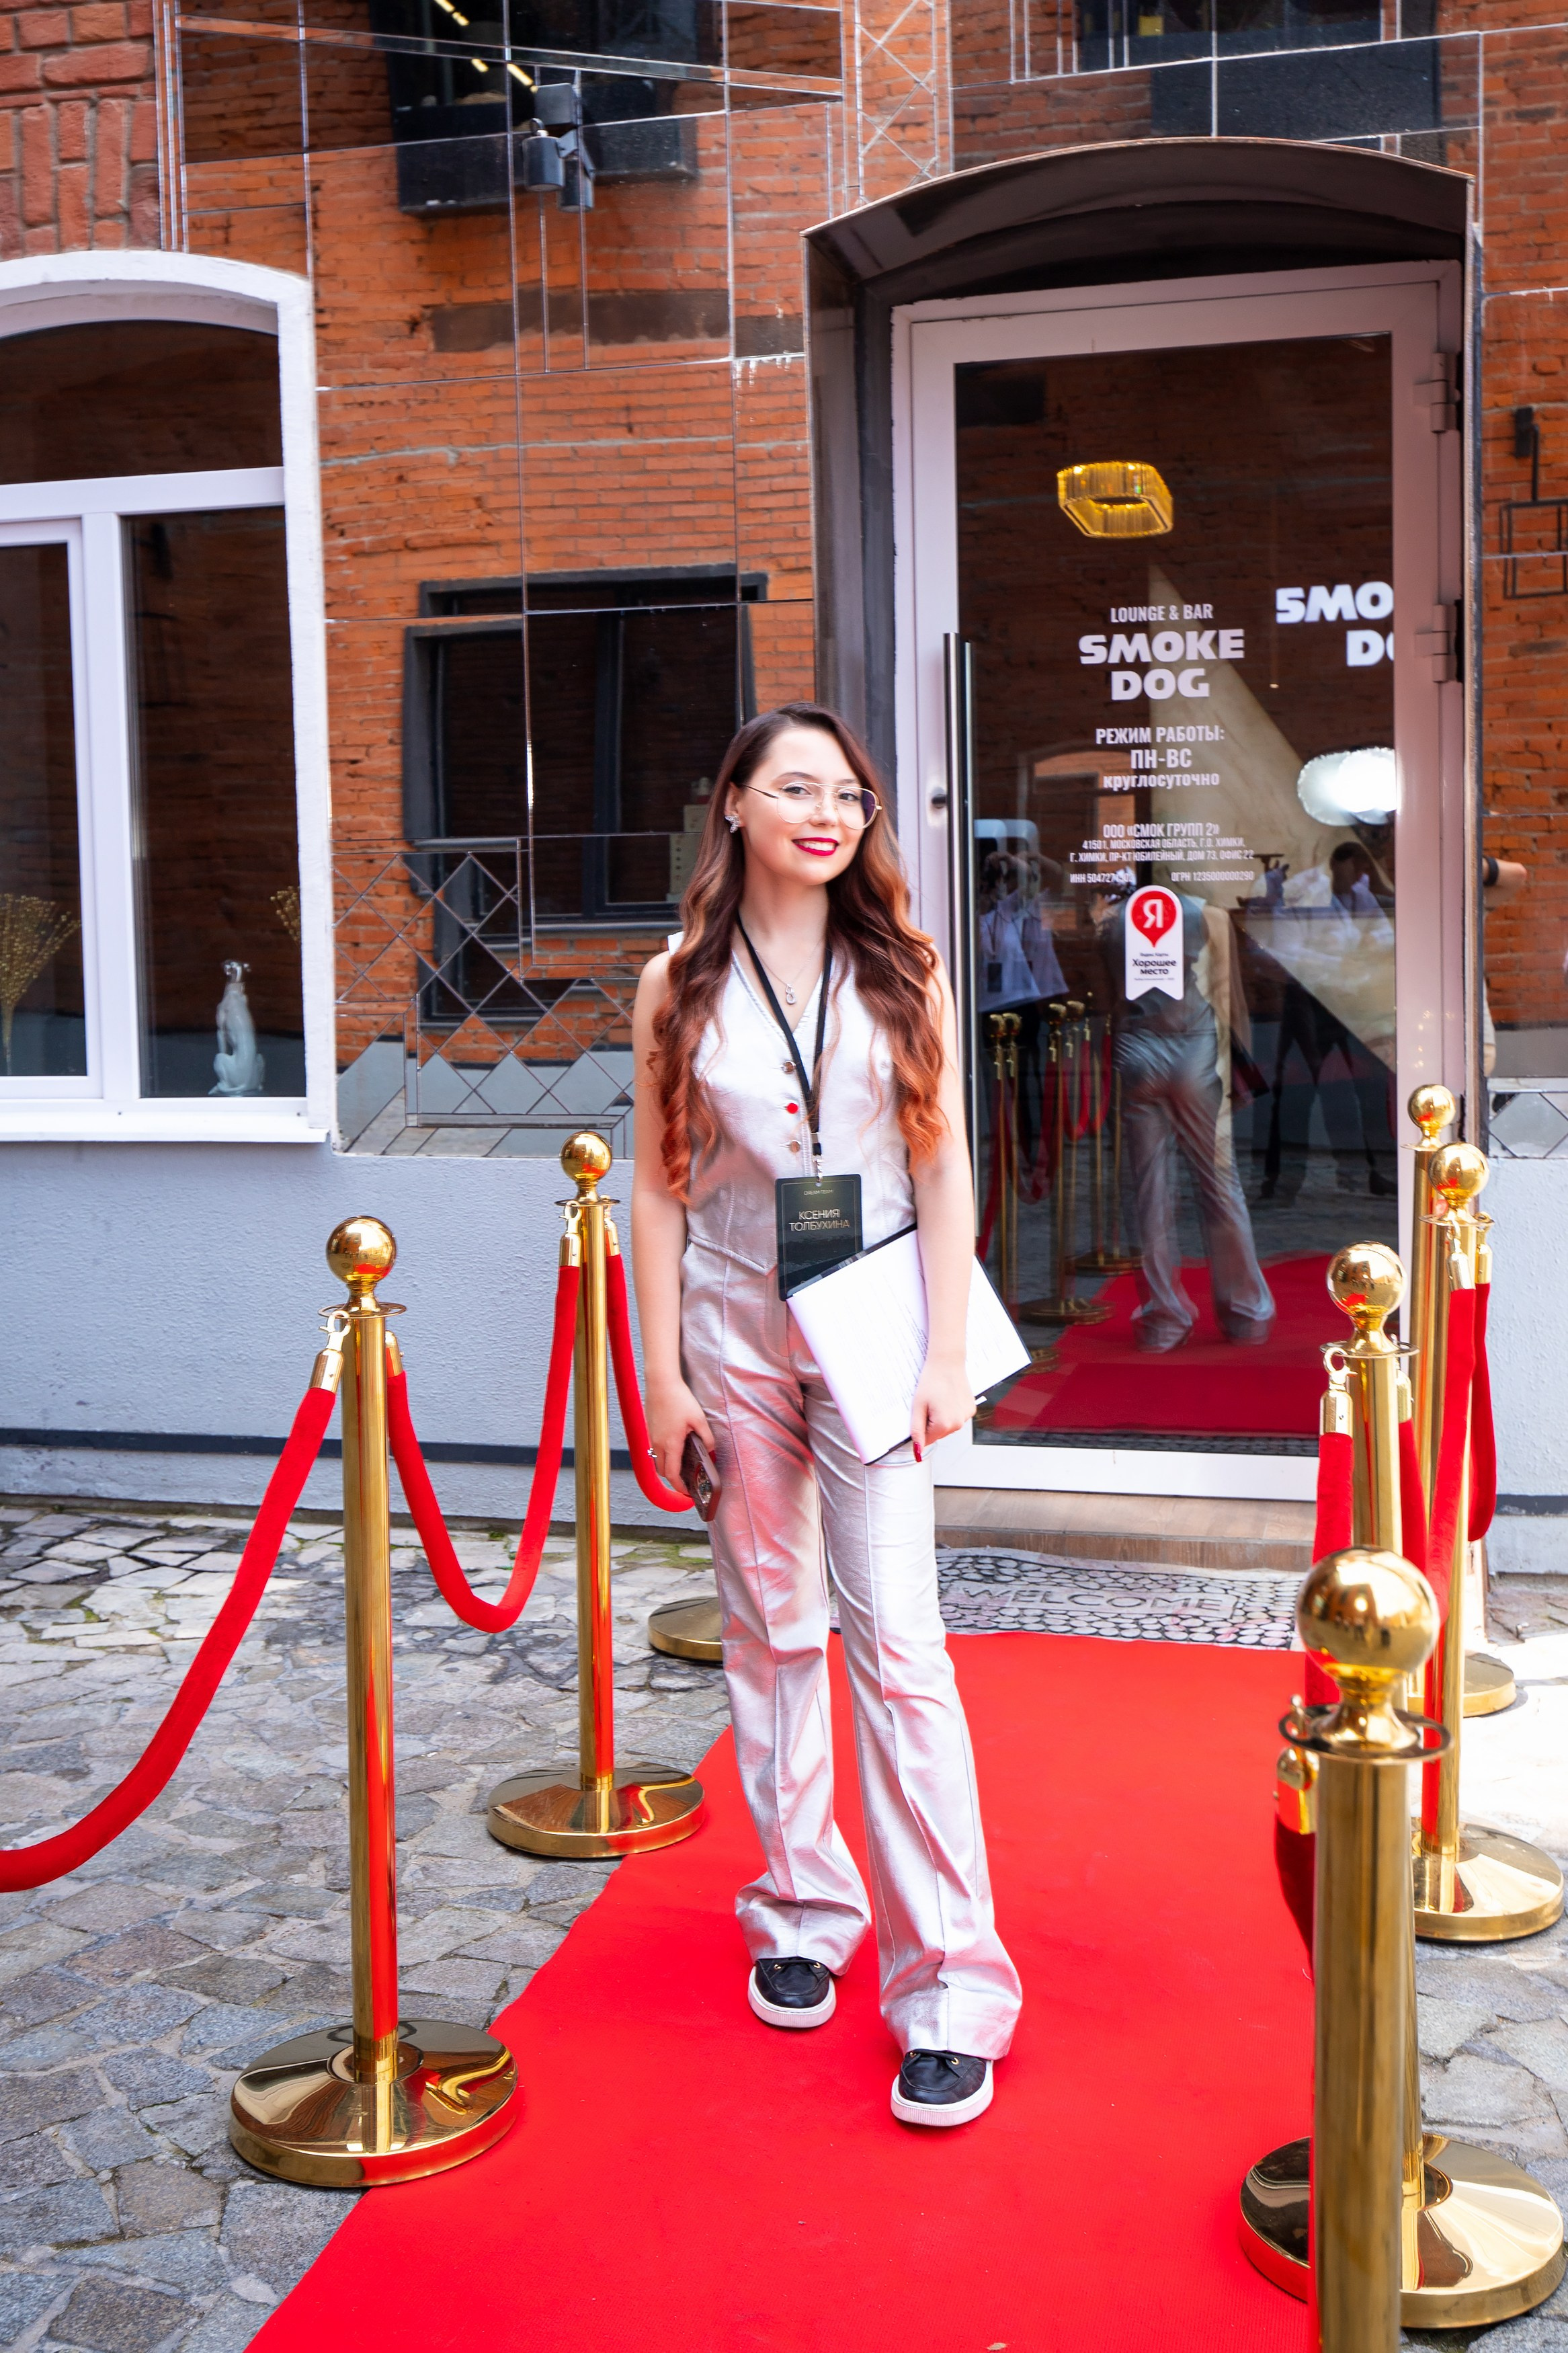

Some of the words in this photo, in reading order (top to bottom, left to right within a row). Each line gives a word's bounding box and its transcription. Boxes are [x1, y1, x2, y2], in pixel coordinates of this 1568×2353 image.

[1110, 605, 1165, 623] LOUNGE
[1169, 605, 1180, 621] &
[1184, 604, 1213, 620] BAR
[1078, 629, 1245, 664] SMOKE
[1346, 629, 1394, 667] D
[1111, 668, 1210, 701] DOG
[1096, 727, 1151, 744] РЕЖИМ
[1155, 725, 1225, 743] РАБОТЫ:
[1130, 748, 1192, 769] ПН-ВС
[1104, 772, 1220, 791] круглосуточно
[1103, 824, 1124, 838] ООО
[1127, 823, 1165, 838] «СМОК
[1167, 823, 1203, 836] ГРУПП
[1206, 822, 1220, 836] 2»
[1110, 839, 1160, 849] МОСКОВСКАЯ
[1109, 852, 1132, 861] ПР-КТ
[1187, 850, 1205, 861] ДОМ
[1219, 850, 1242, 860] ОФИС
[1243, 849, 1254, 860] 22
[1069, 873, 1086, 883] ИНН
[1171, 871, 1191, 881] ОГРН
[1143, 899, 1163, 928] Я
[1132, 959, 1176, 968] Хорошее
[798, 1209, 841, 1220] КСЕНИЯ
[788, 1220, 850, 1232] ТОЛБУХИНА
[962, 1587, 1223, 1611] WELCOME
